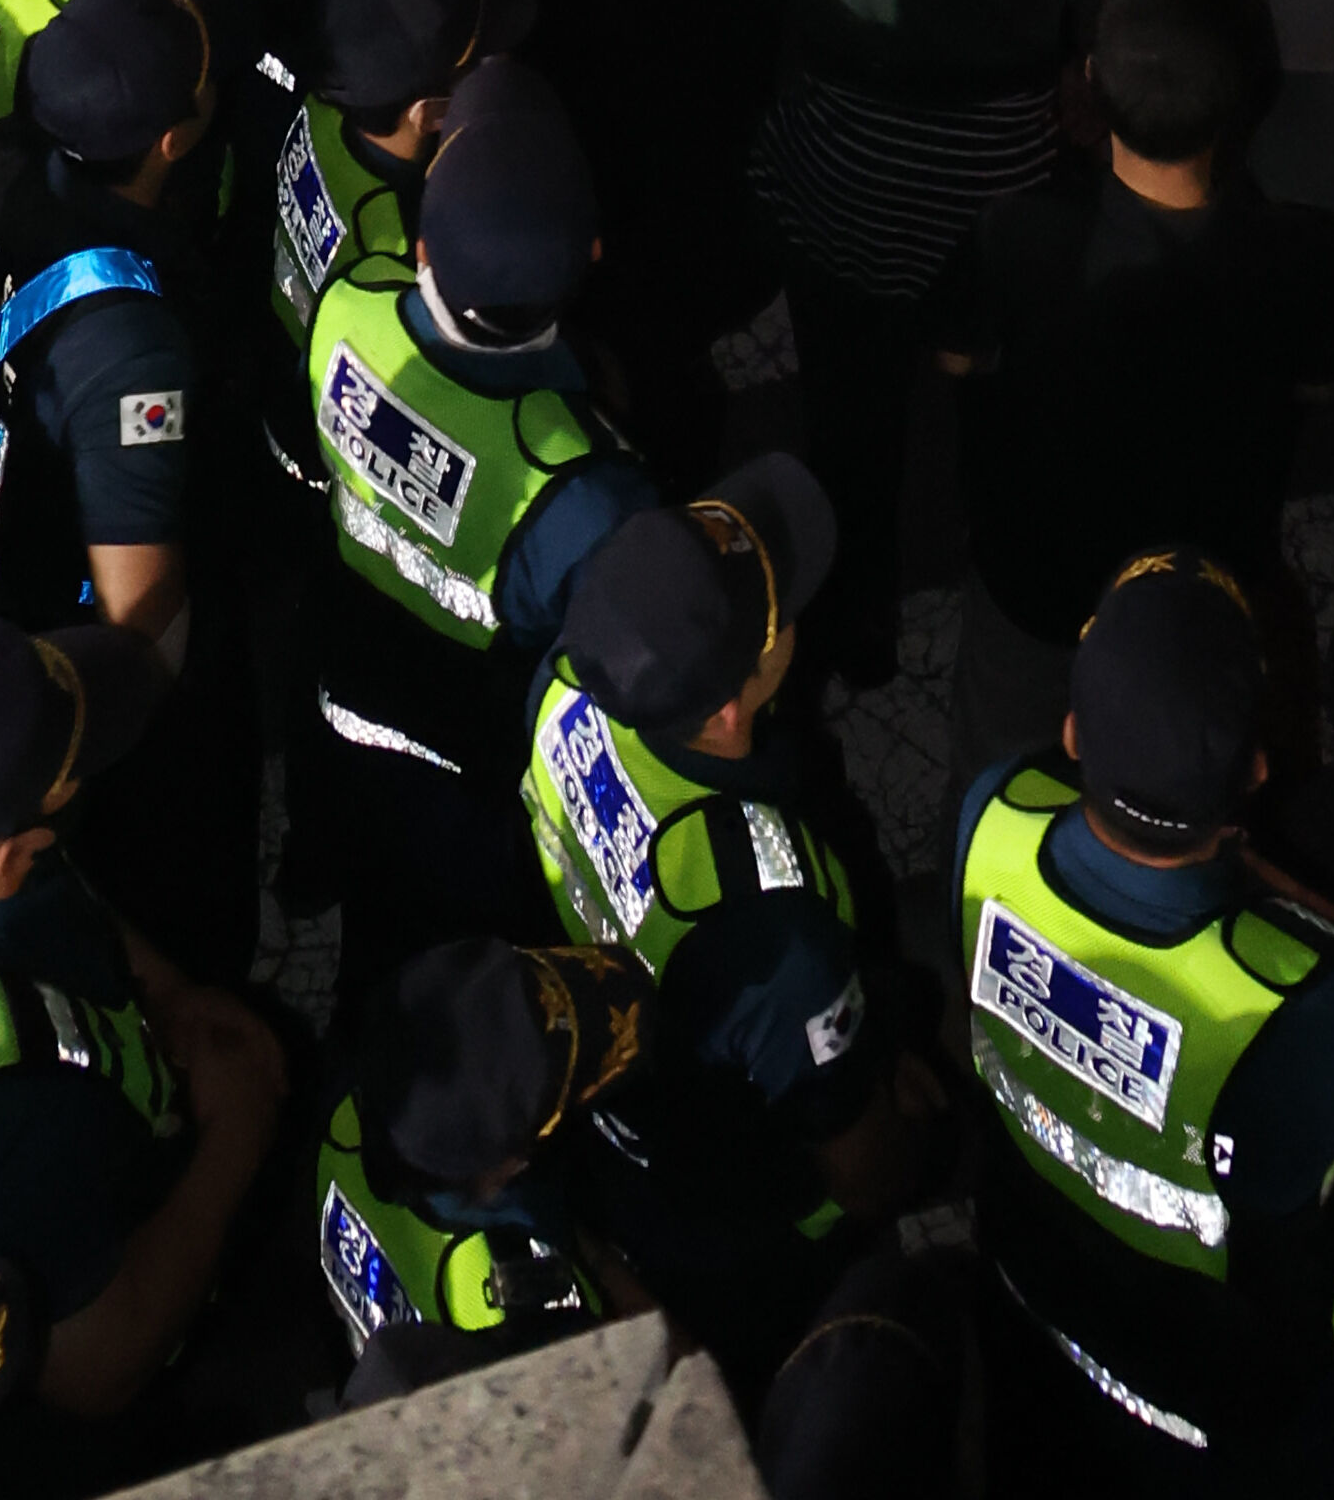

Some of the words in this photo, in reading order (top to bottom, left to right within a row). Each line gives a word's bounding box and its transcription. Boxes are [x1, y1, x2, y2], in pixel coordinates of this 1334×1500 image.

[331, 414, 440, 522] POLICE
[340, 365, 453, 495] 경찰
[996, 983, 1147, 1104] POLICE
[1007, 928, 1155, 1072] 경찰
